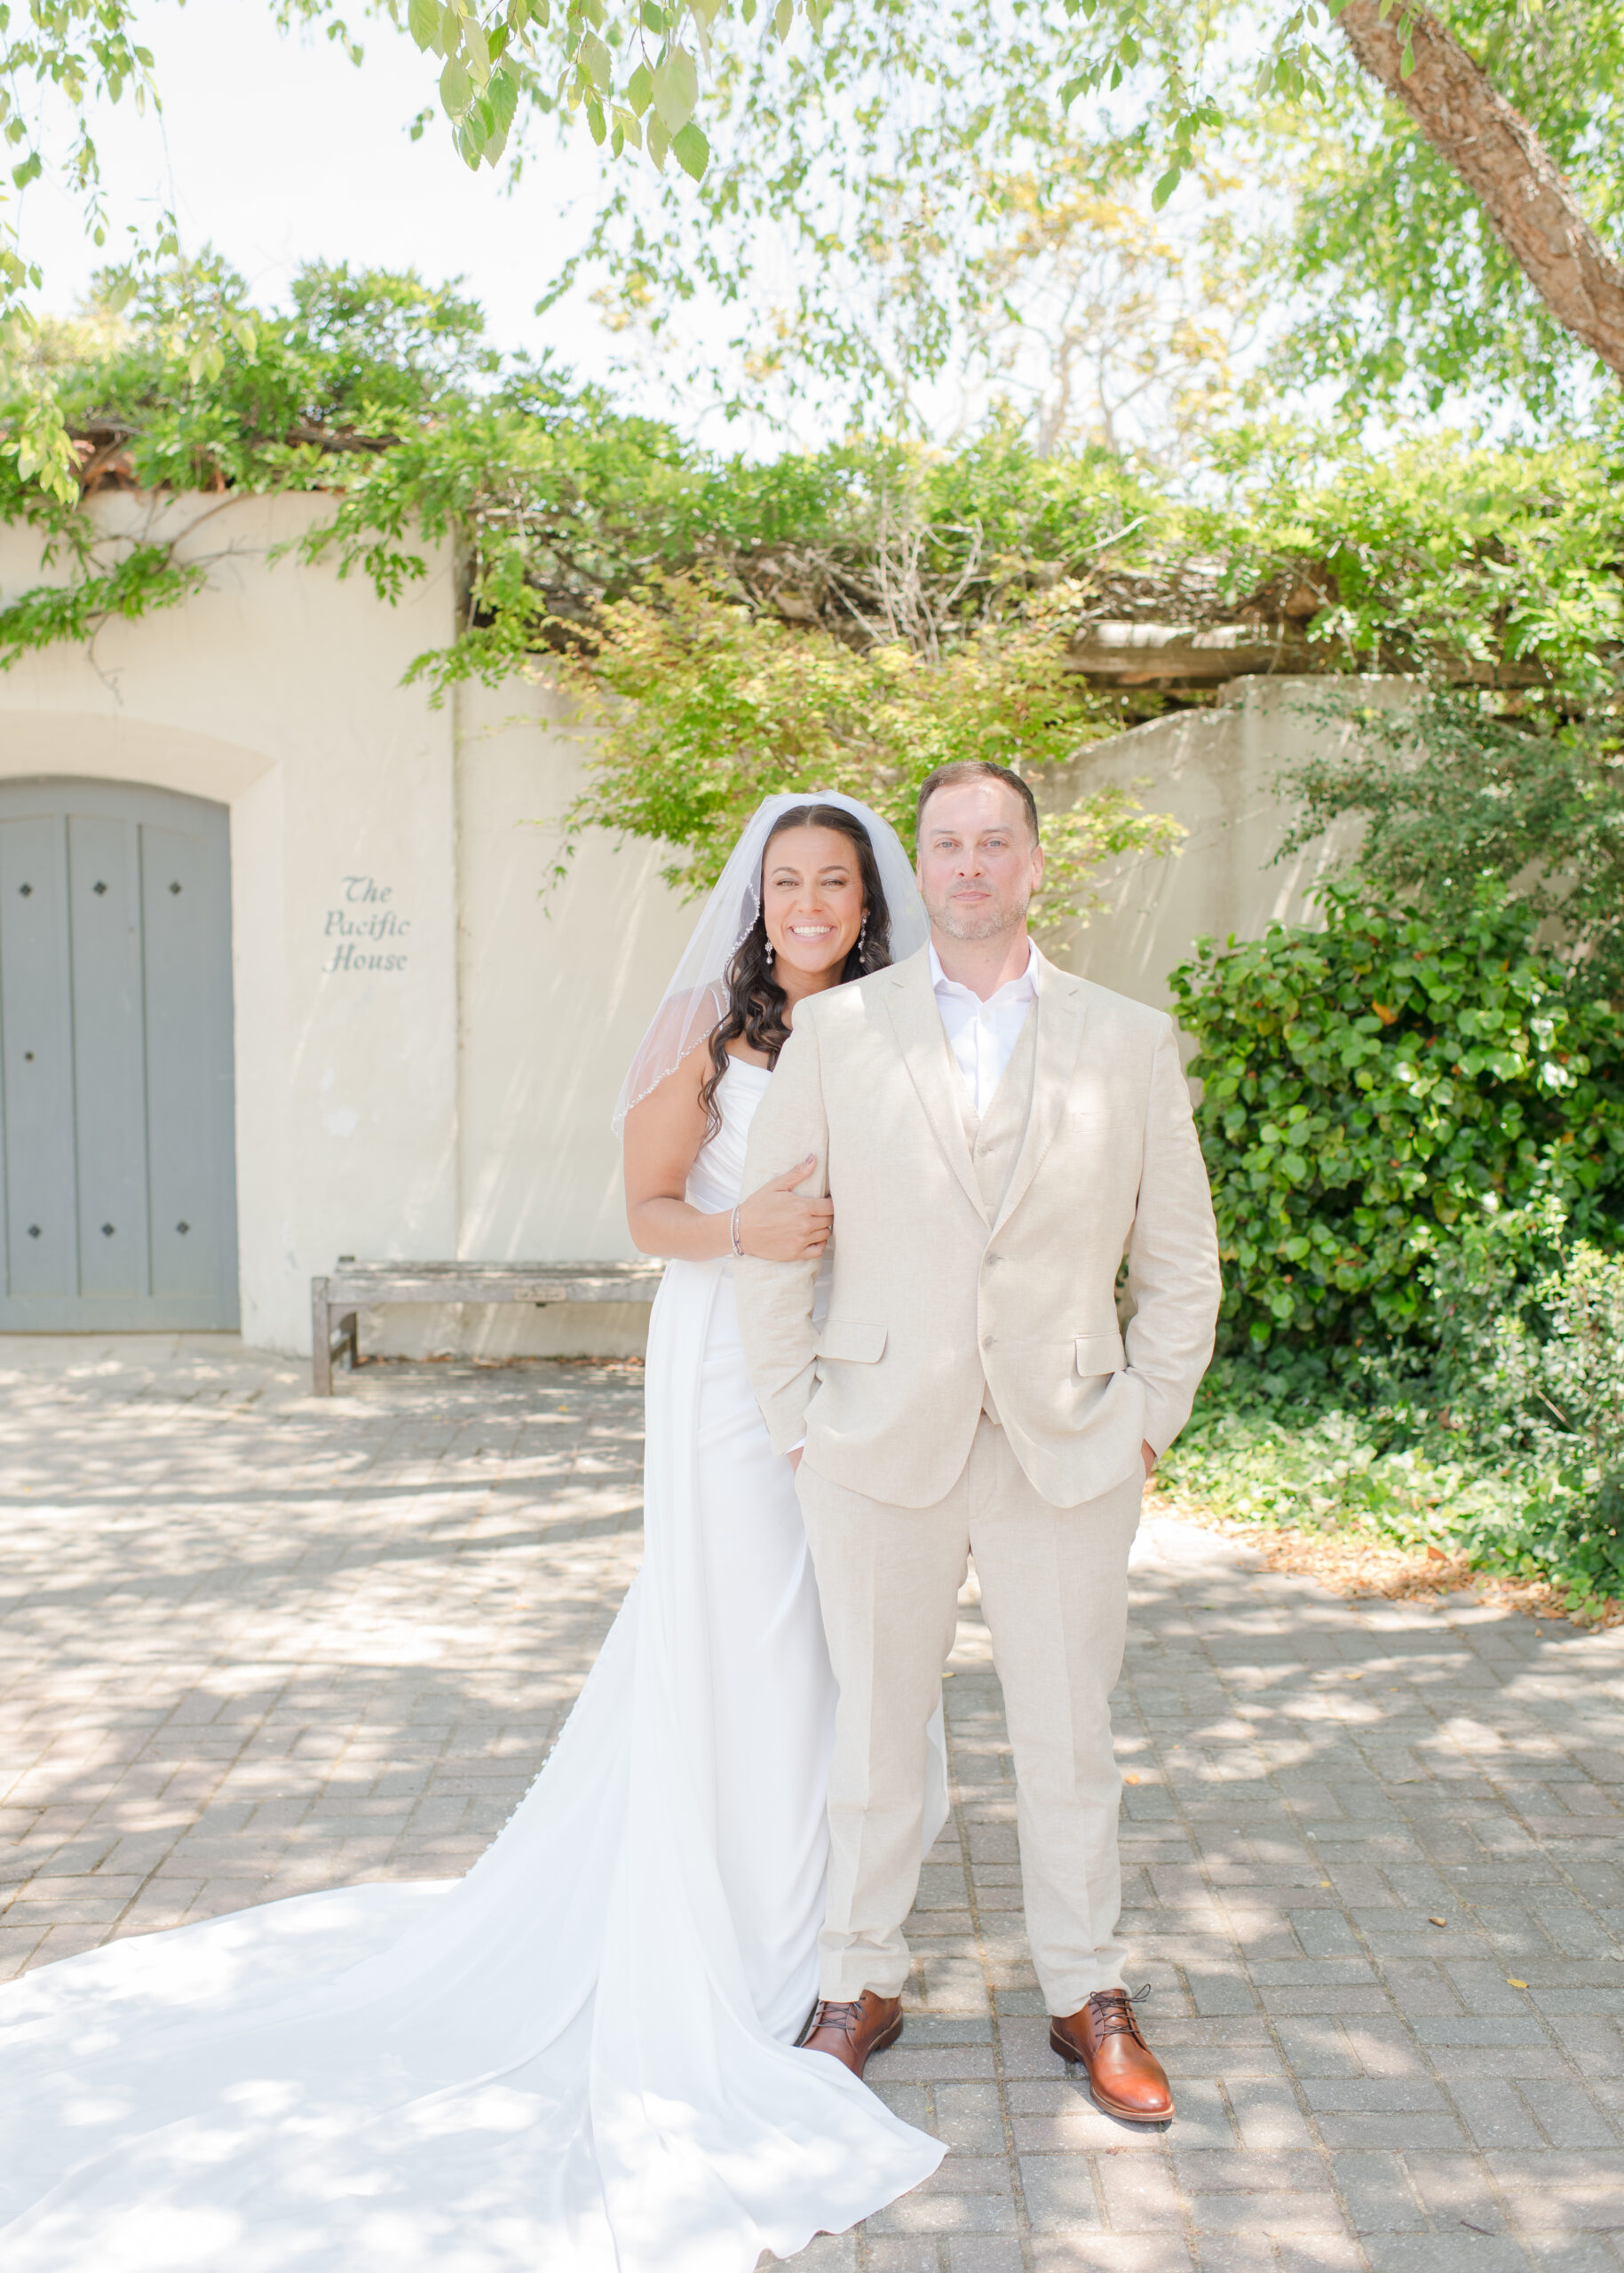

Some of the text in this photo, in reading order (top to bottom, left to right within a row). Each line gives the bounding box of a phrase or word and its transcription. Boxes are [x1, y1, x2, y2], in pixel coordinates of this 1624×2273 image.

[342, 875, 392, 903] The
[324, 909, 411, 941] Pacific
[322, 942, 408, 972] House
